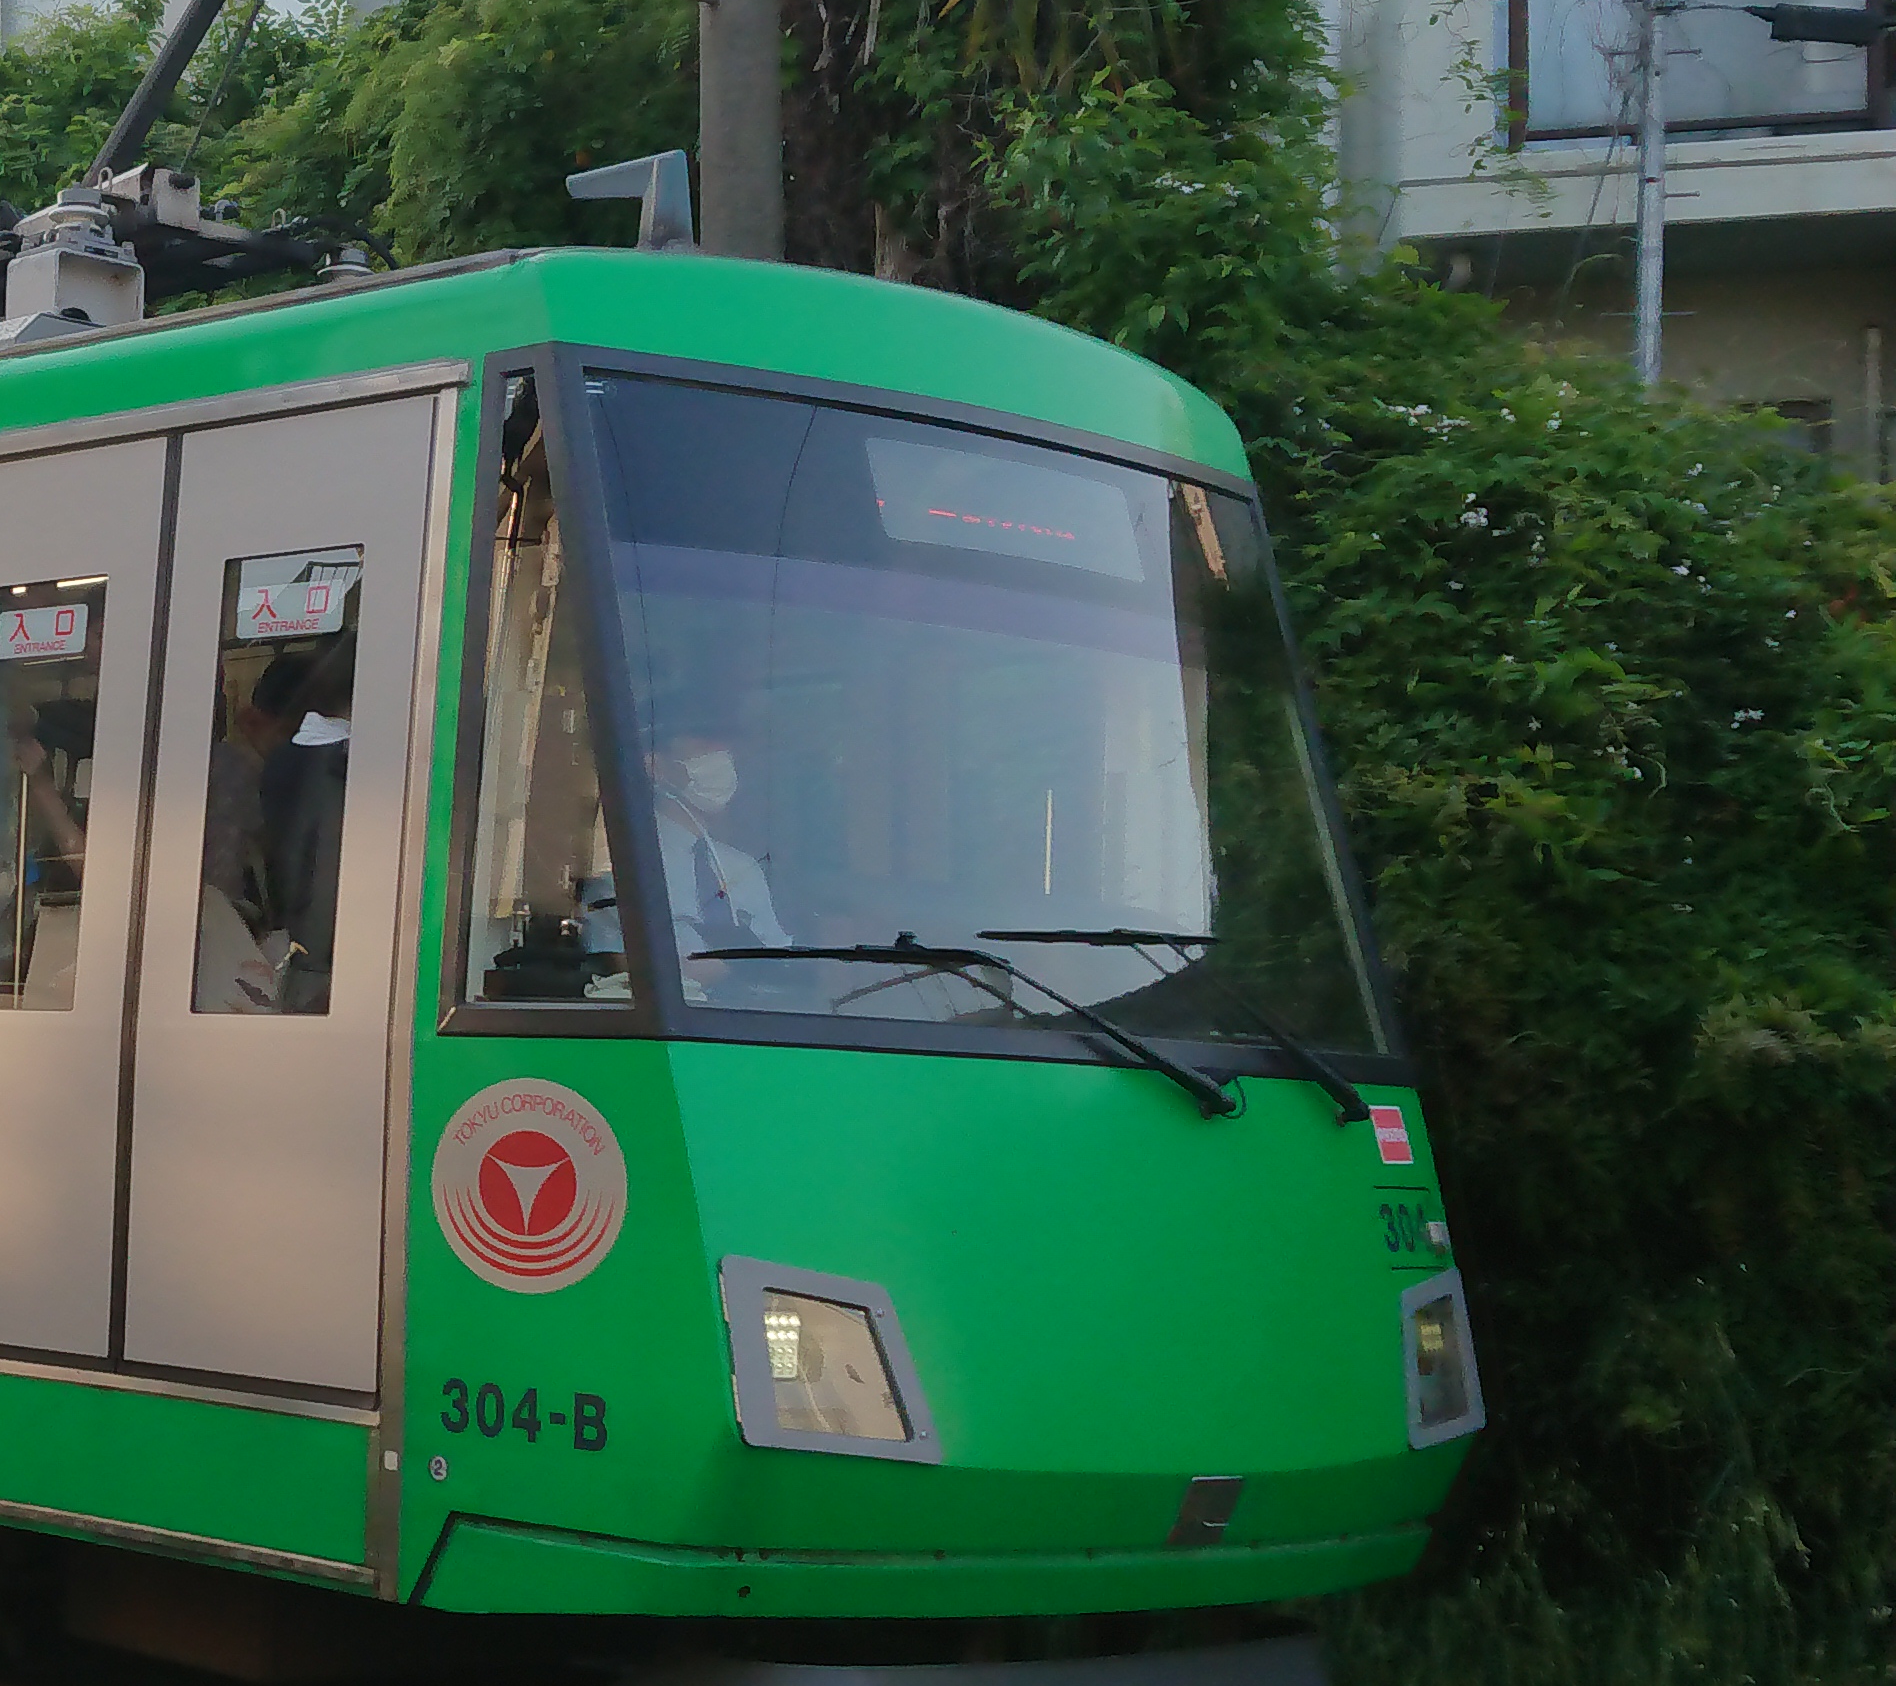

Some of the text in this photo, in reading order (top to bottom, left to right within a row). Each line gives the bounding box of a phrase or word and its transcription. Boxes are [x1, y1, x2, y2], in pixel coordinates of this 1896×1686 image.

[251, 585, 330, 620] 入口
[9, 609, 75, 642] 入口
[257, 618, 320, 634] ENTRANCE
[14, 639, 66, 654] ENTRANCE
[453, 1093, 606, 1156] TOKYU CORPORATION
[440, 1377, 608, 1451] 304-B
